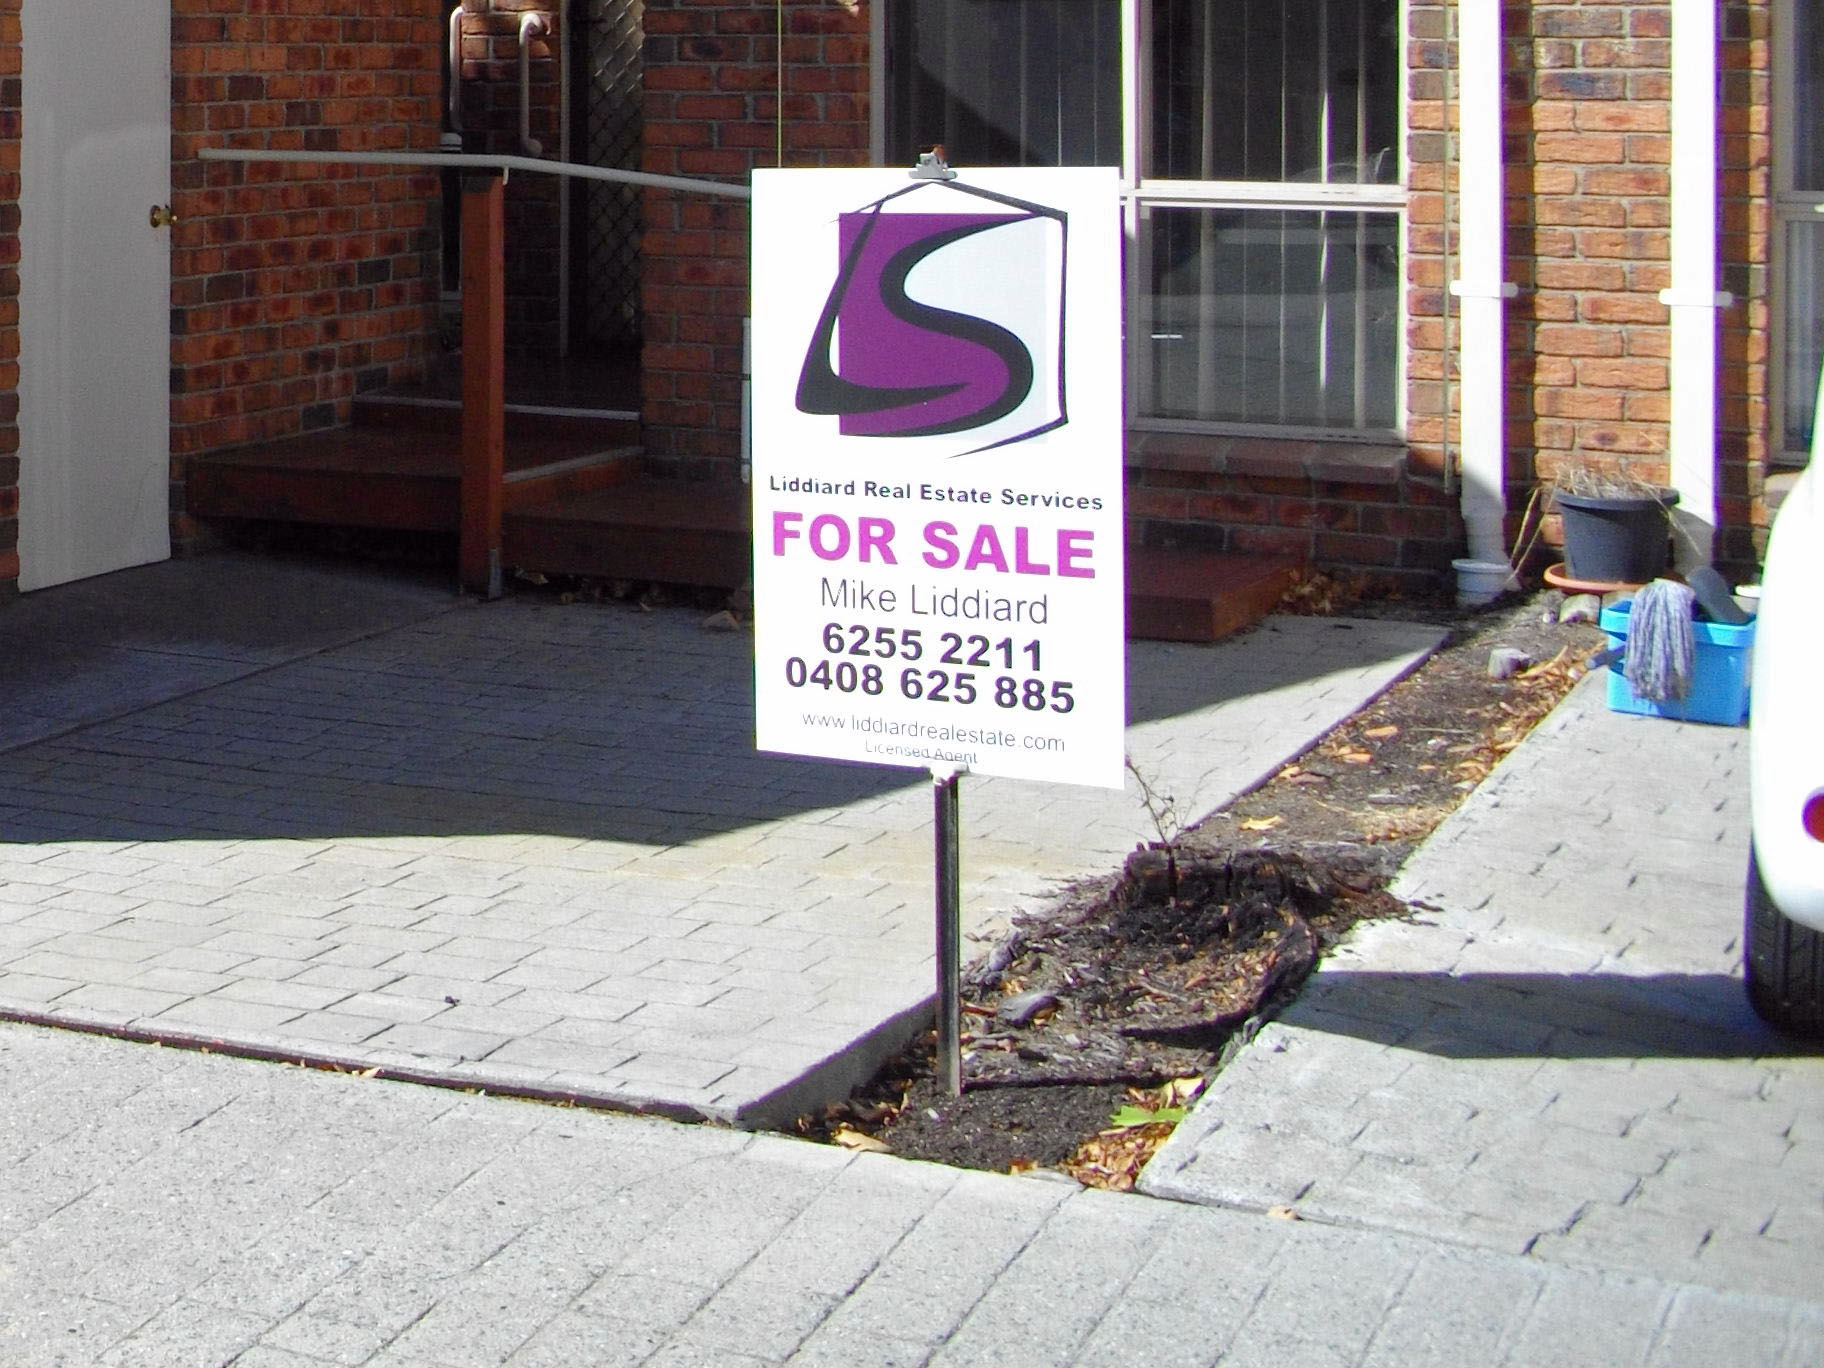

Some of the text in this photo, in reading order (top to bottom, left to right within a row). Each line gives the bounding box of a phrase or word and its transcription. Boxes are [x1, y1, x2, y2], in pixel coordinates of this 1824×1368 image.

[770, 475, 1104, 511] Liddiard Real Estate Services
[772, 511, 1096, 579] FOR SALE
[821, 577, 1048, 625] Mike Liddiard
[822, 622, 1041, 671] 6255 2211
[785, 656, 1075, 714] 0408 625 885
[802, 712, 1065, 752] wwwliddiardrealestate.com
